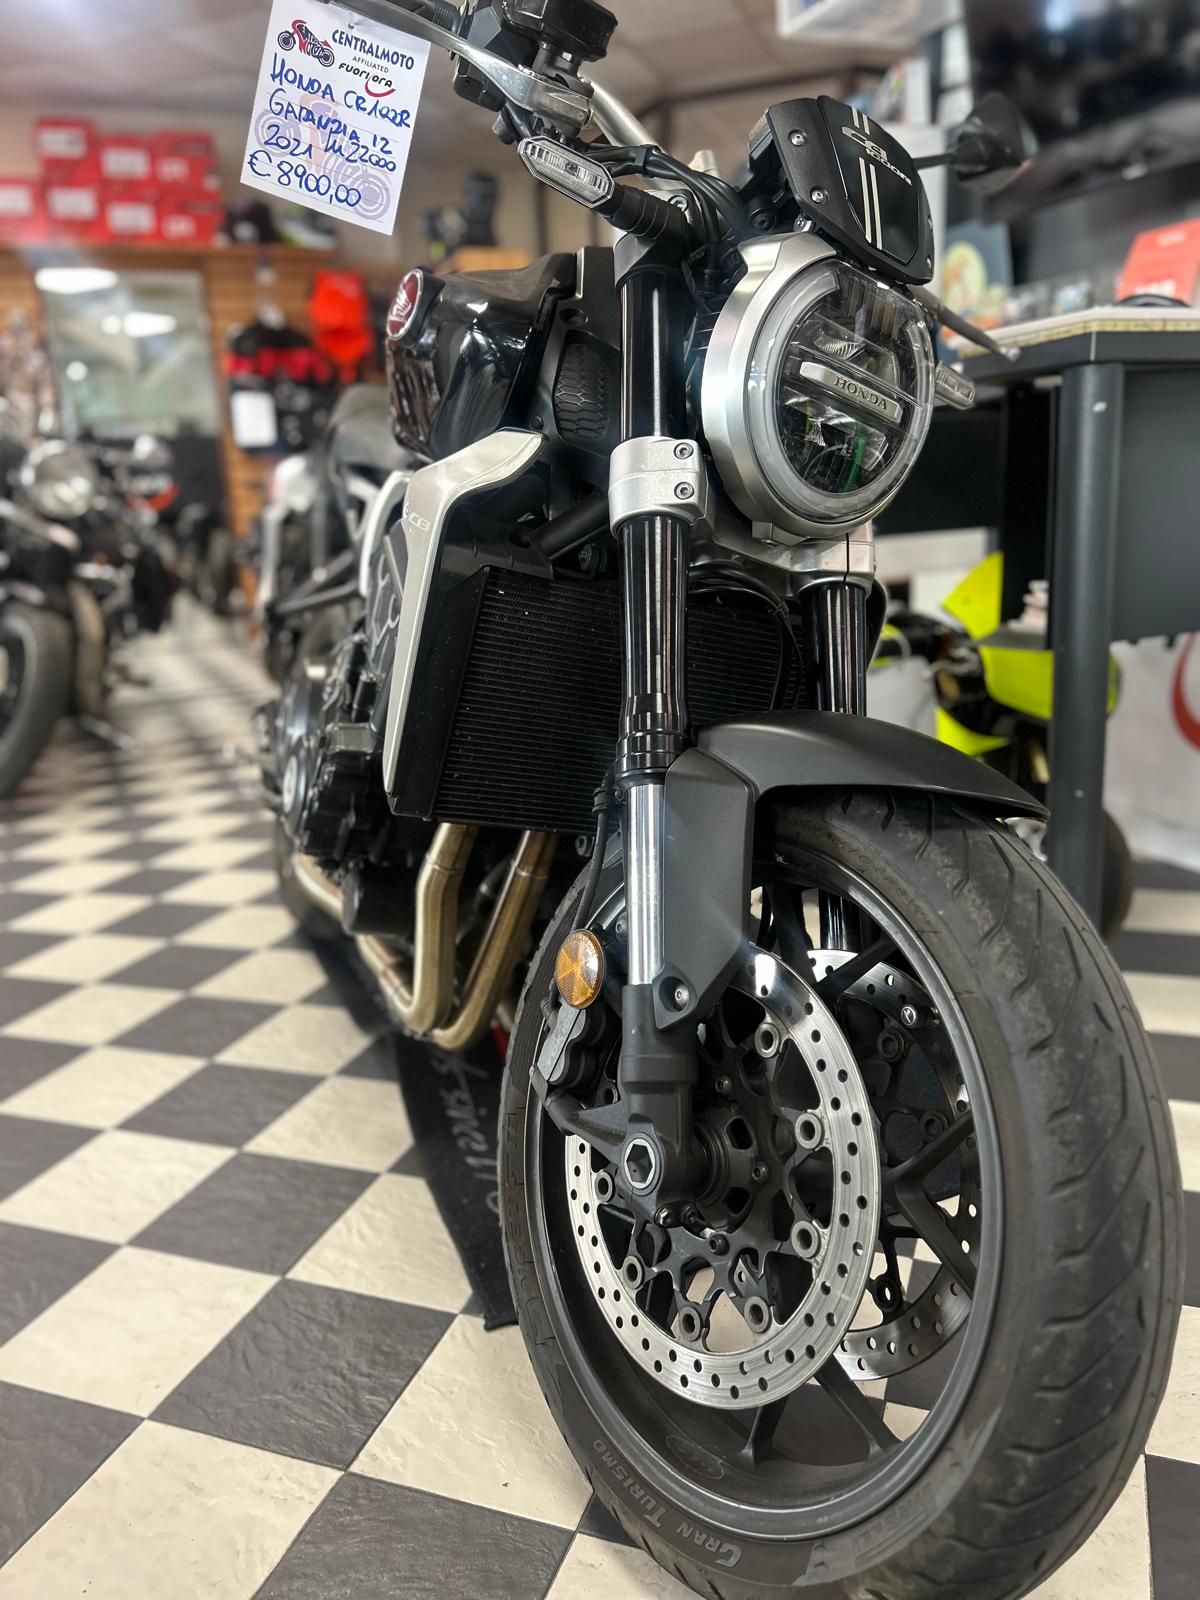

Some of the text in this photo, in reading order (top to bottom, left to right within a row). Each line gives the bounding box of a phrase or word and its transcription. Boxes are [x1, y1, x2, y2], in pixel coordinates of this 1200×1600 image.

[332, 29, 415, 70] CENTRALMOTO
[352, 56, 389, 73] AFFILIATED
[270, 52, 336, 102] HONDA
[263, 124, 313, 160] 2021
[372, 134, 393, 155] 12
[841, 126, 888, 161] CB
[833, 376, 888, 411] HONDA
[408, 511, 431, 532] CB
[592, 1439, 667, 1528] TURISMO
[676, 1522, 742, 1568] GRAN
